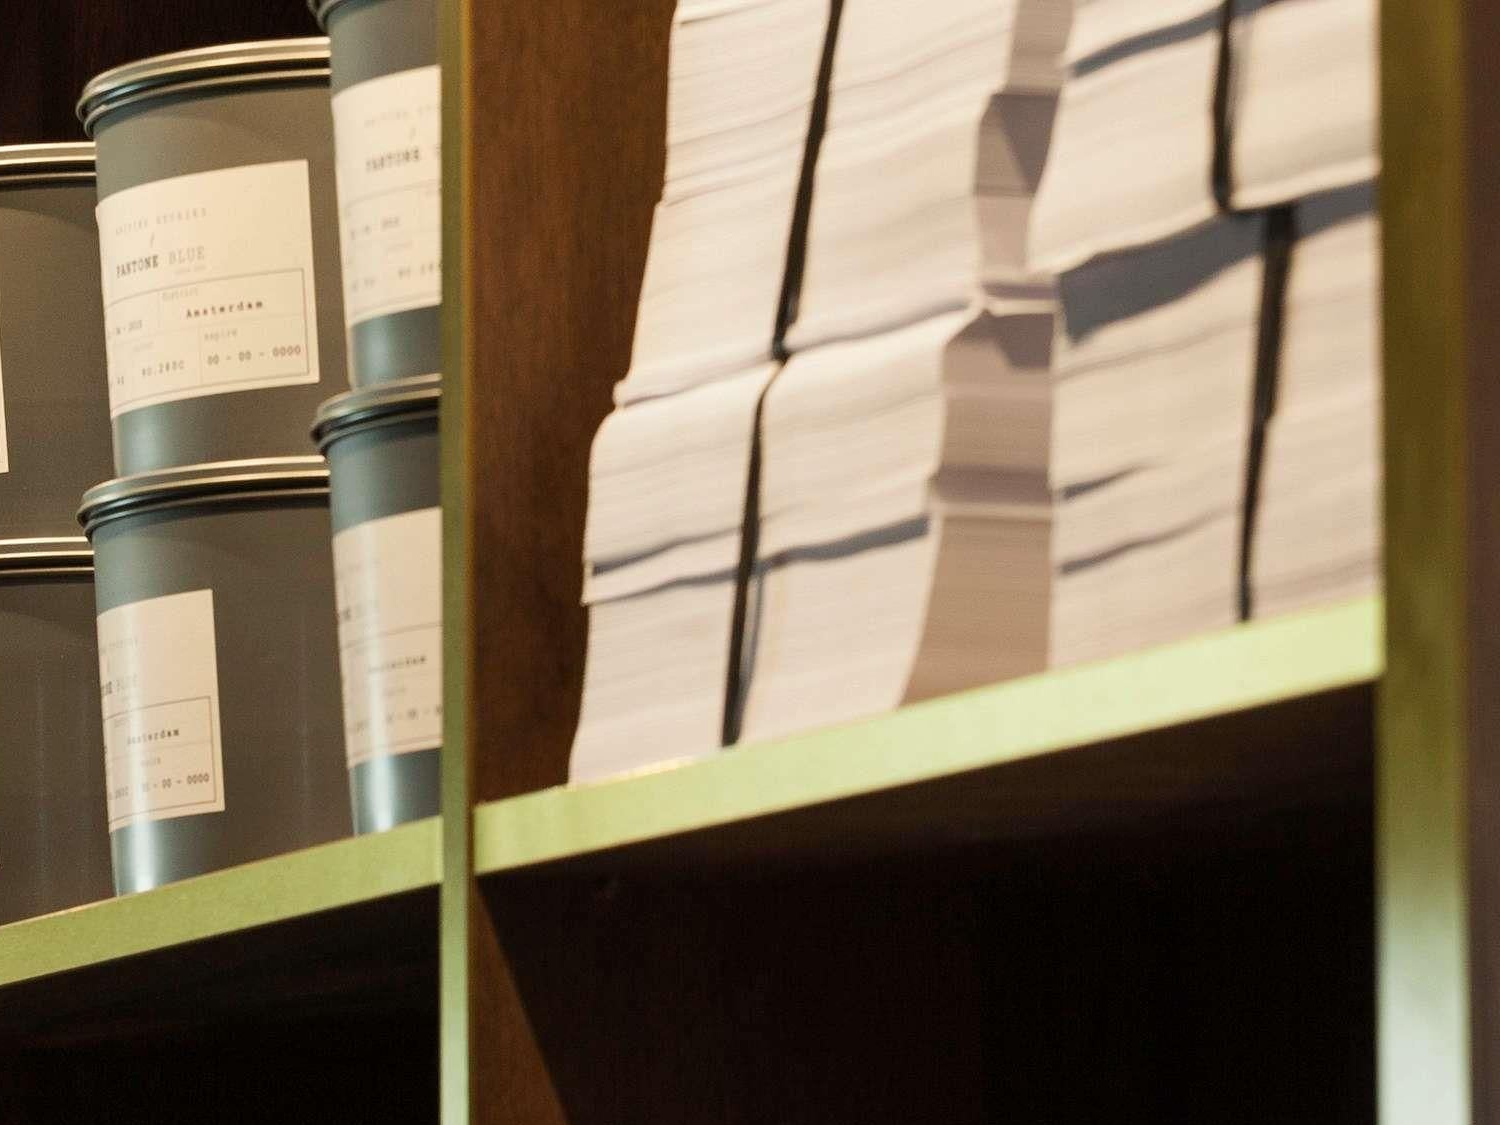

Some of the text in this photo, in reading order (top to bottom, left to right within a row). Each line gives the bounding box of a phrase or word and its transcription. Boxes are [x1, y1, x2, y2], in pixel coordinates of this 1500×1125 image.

[116, 255, 159, 279] PANTONE
[169, 246, 205, 265] BLUE
[186, 300, 263, 319] Amsterdam
